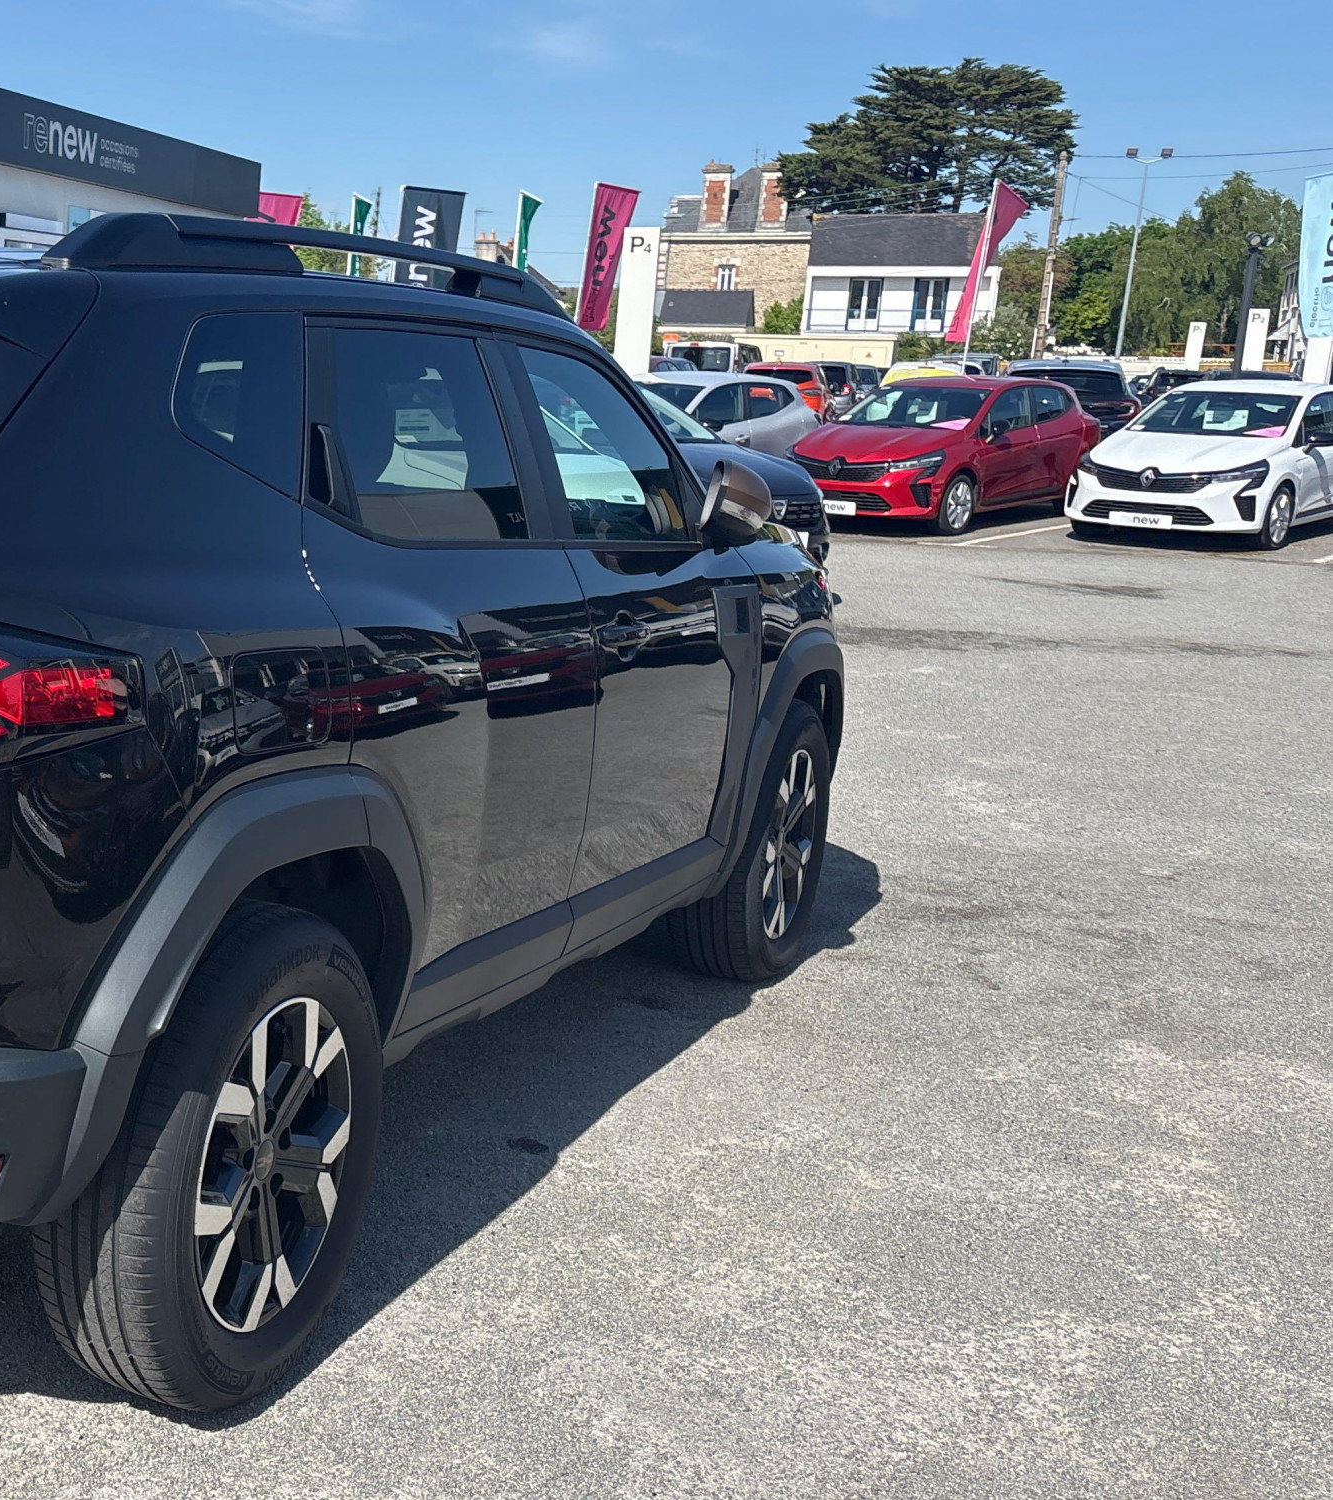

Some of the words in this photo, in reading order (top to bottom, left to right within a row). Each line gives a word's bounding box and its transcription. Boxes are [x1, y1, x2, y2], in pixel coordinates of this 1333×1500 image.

[23, 112, 98, 165] renew
[100, 138, 140, 159] occasions
[1120, 515, 1160, 525] new
